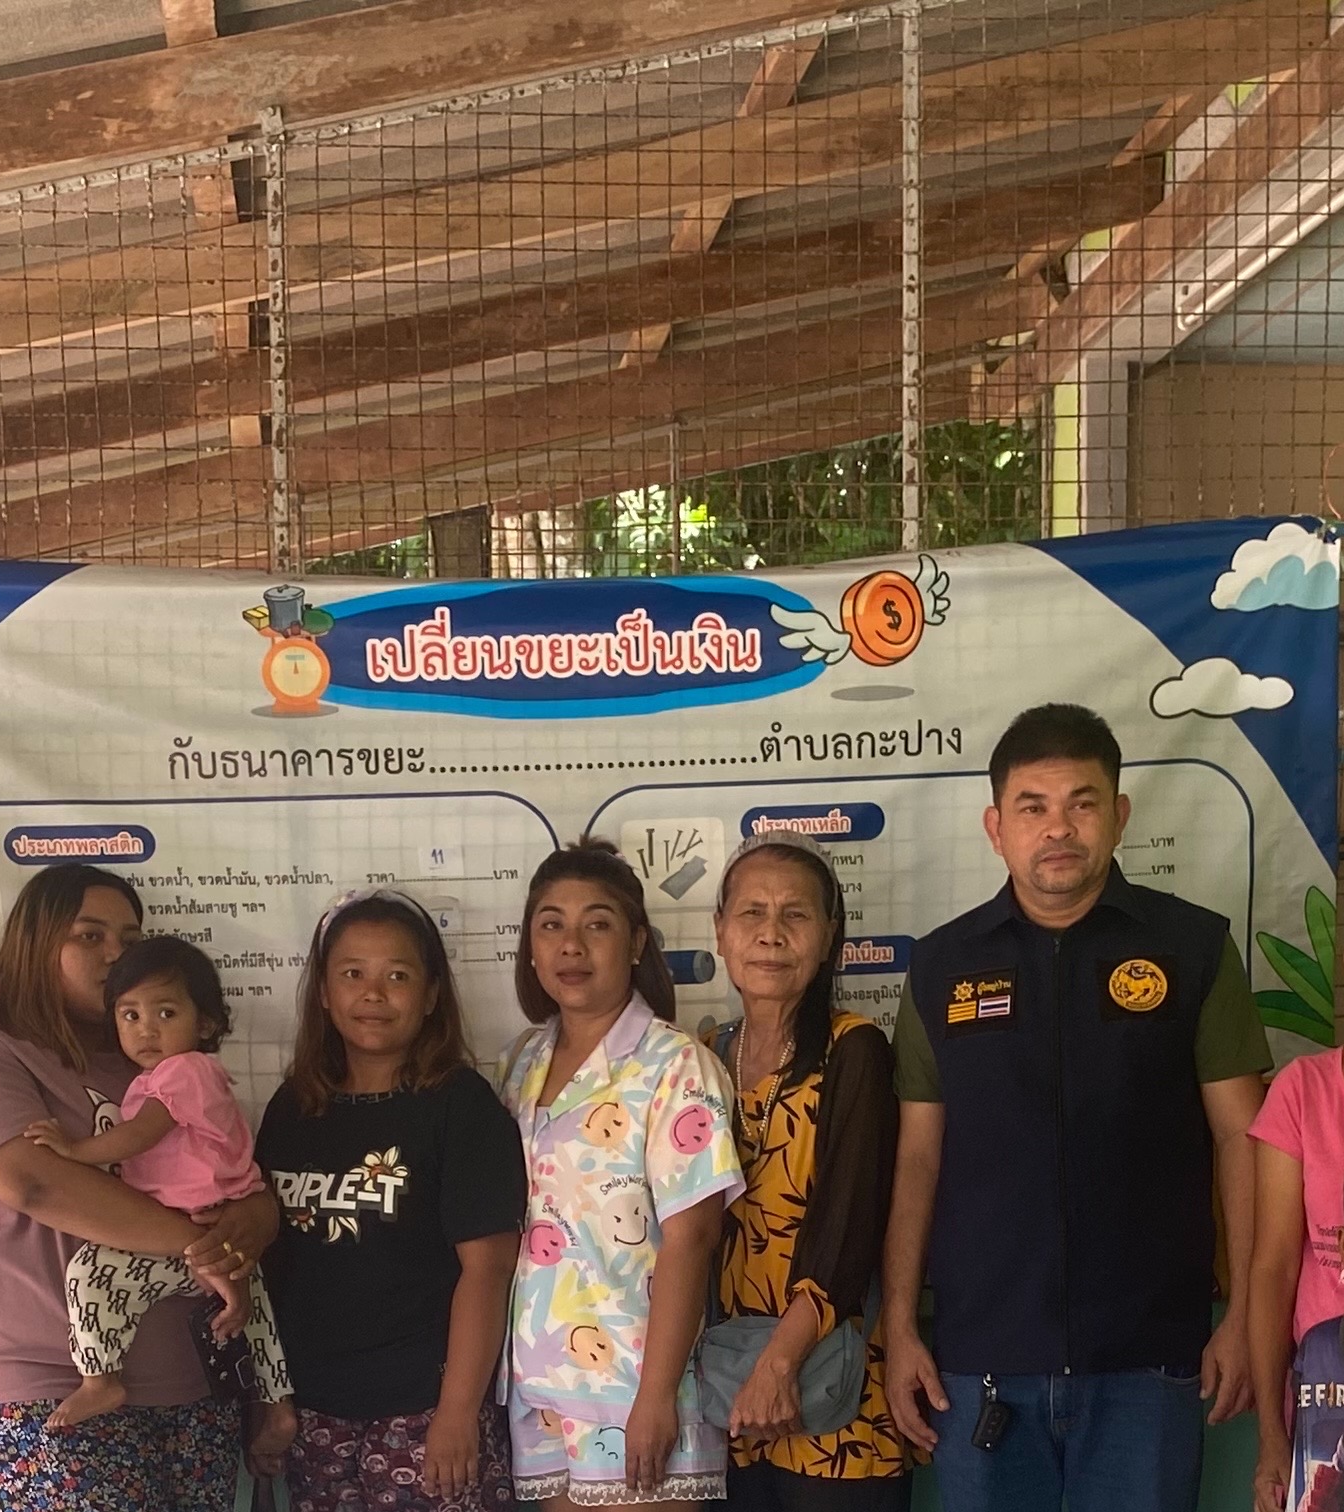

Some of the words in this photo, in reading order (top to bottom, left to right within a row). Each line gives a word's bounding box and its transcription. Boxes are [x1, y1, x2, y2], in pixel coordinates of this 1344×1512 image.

[365, 606, 762, 683] เปลี่ยนขยะเป็นเงิน
[12, 830, 144, 858] ประเภทพลาสติก
[1150, 836, 1175, 849] บาท
[1151, 864, 1175, 876] บาท
